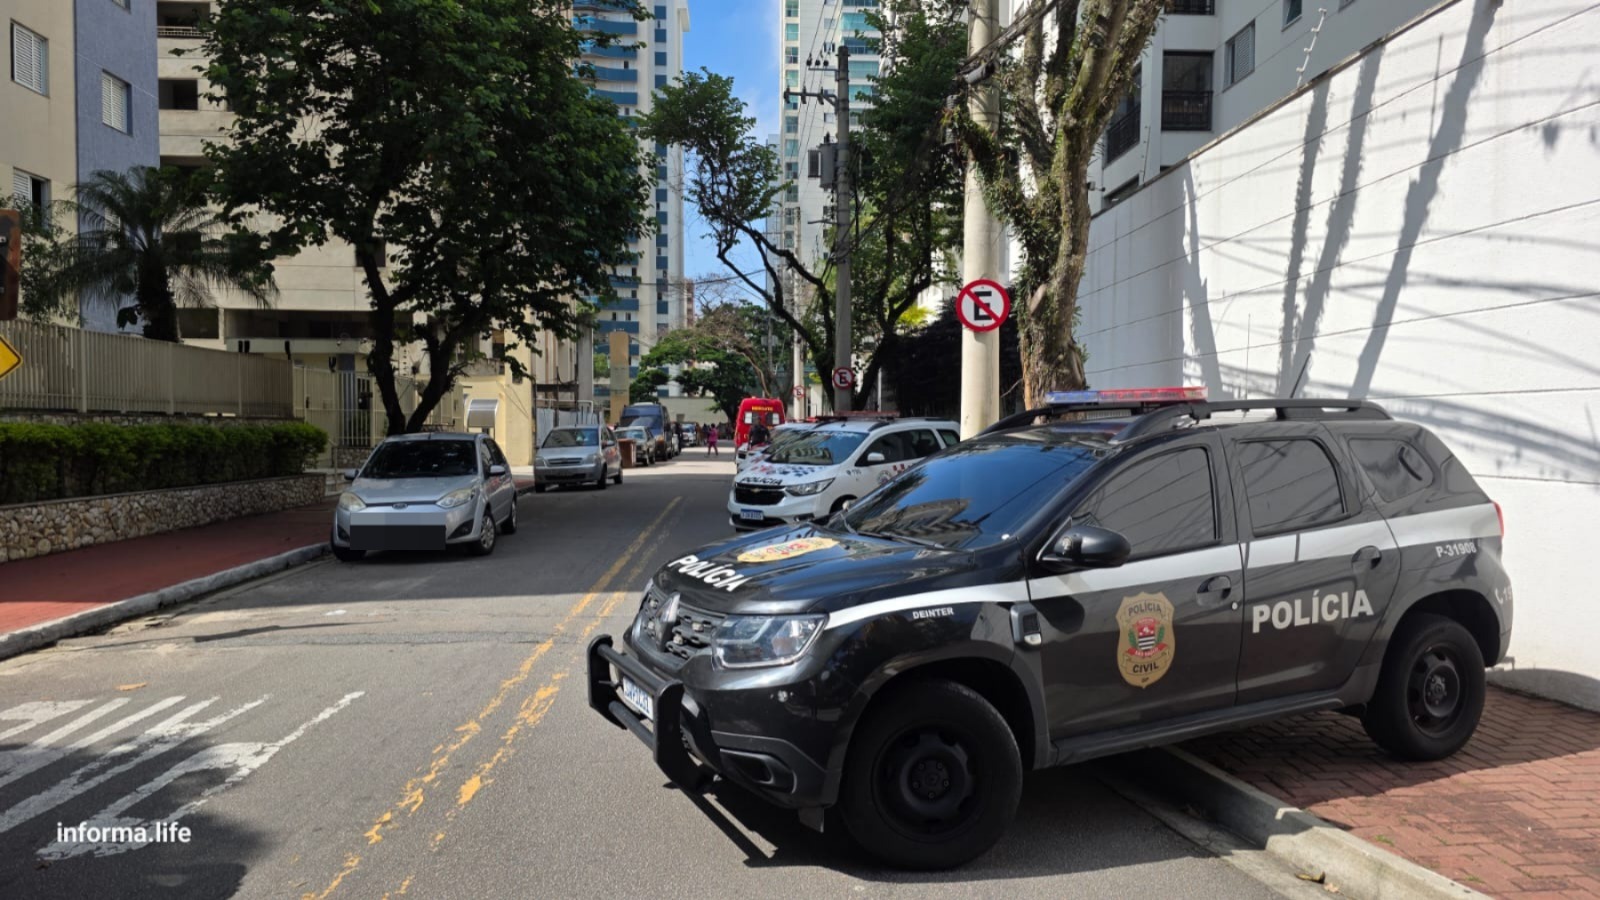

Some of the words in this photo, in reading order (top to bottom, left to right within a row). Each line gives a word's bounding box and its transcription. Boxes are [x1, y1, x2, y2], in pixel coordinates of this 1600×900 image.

[974, 291, 992, 320] E
[1435, 542, 1477, 558] P-31908
[667, 554, 752, 592] POLÍCIA
[912, 606, 954, 620] DEINTER
[1128, 600, 1162, 616] POLÍCIA
[1252, 589, 1374, 633] POLÍCIA
[1132, 662, 1159, 673] CIVIL
